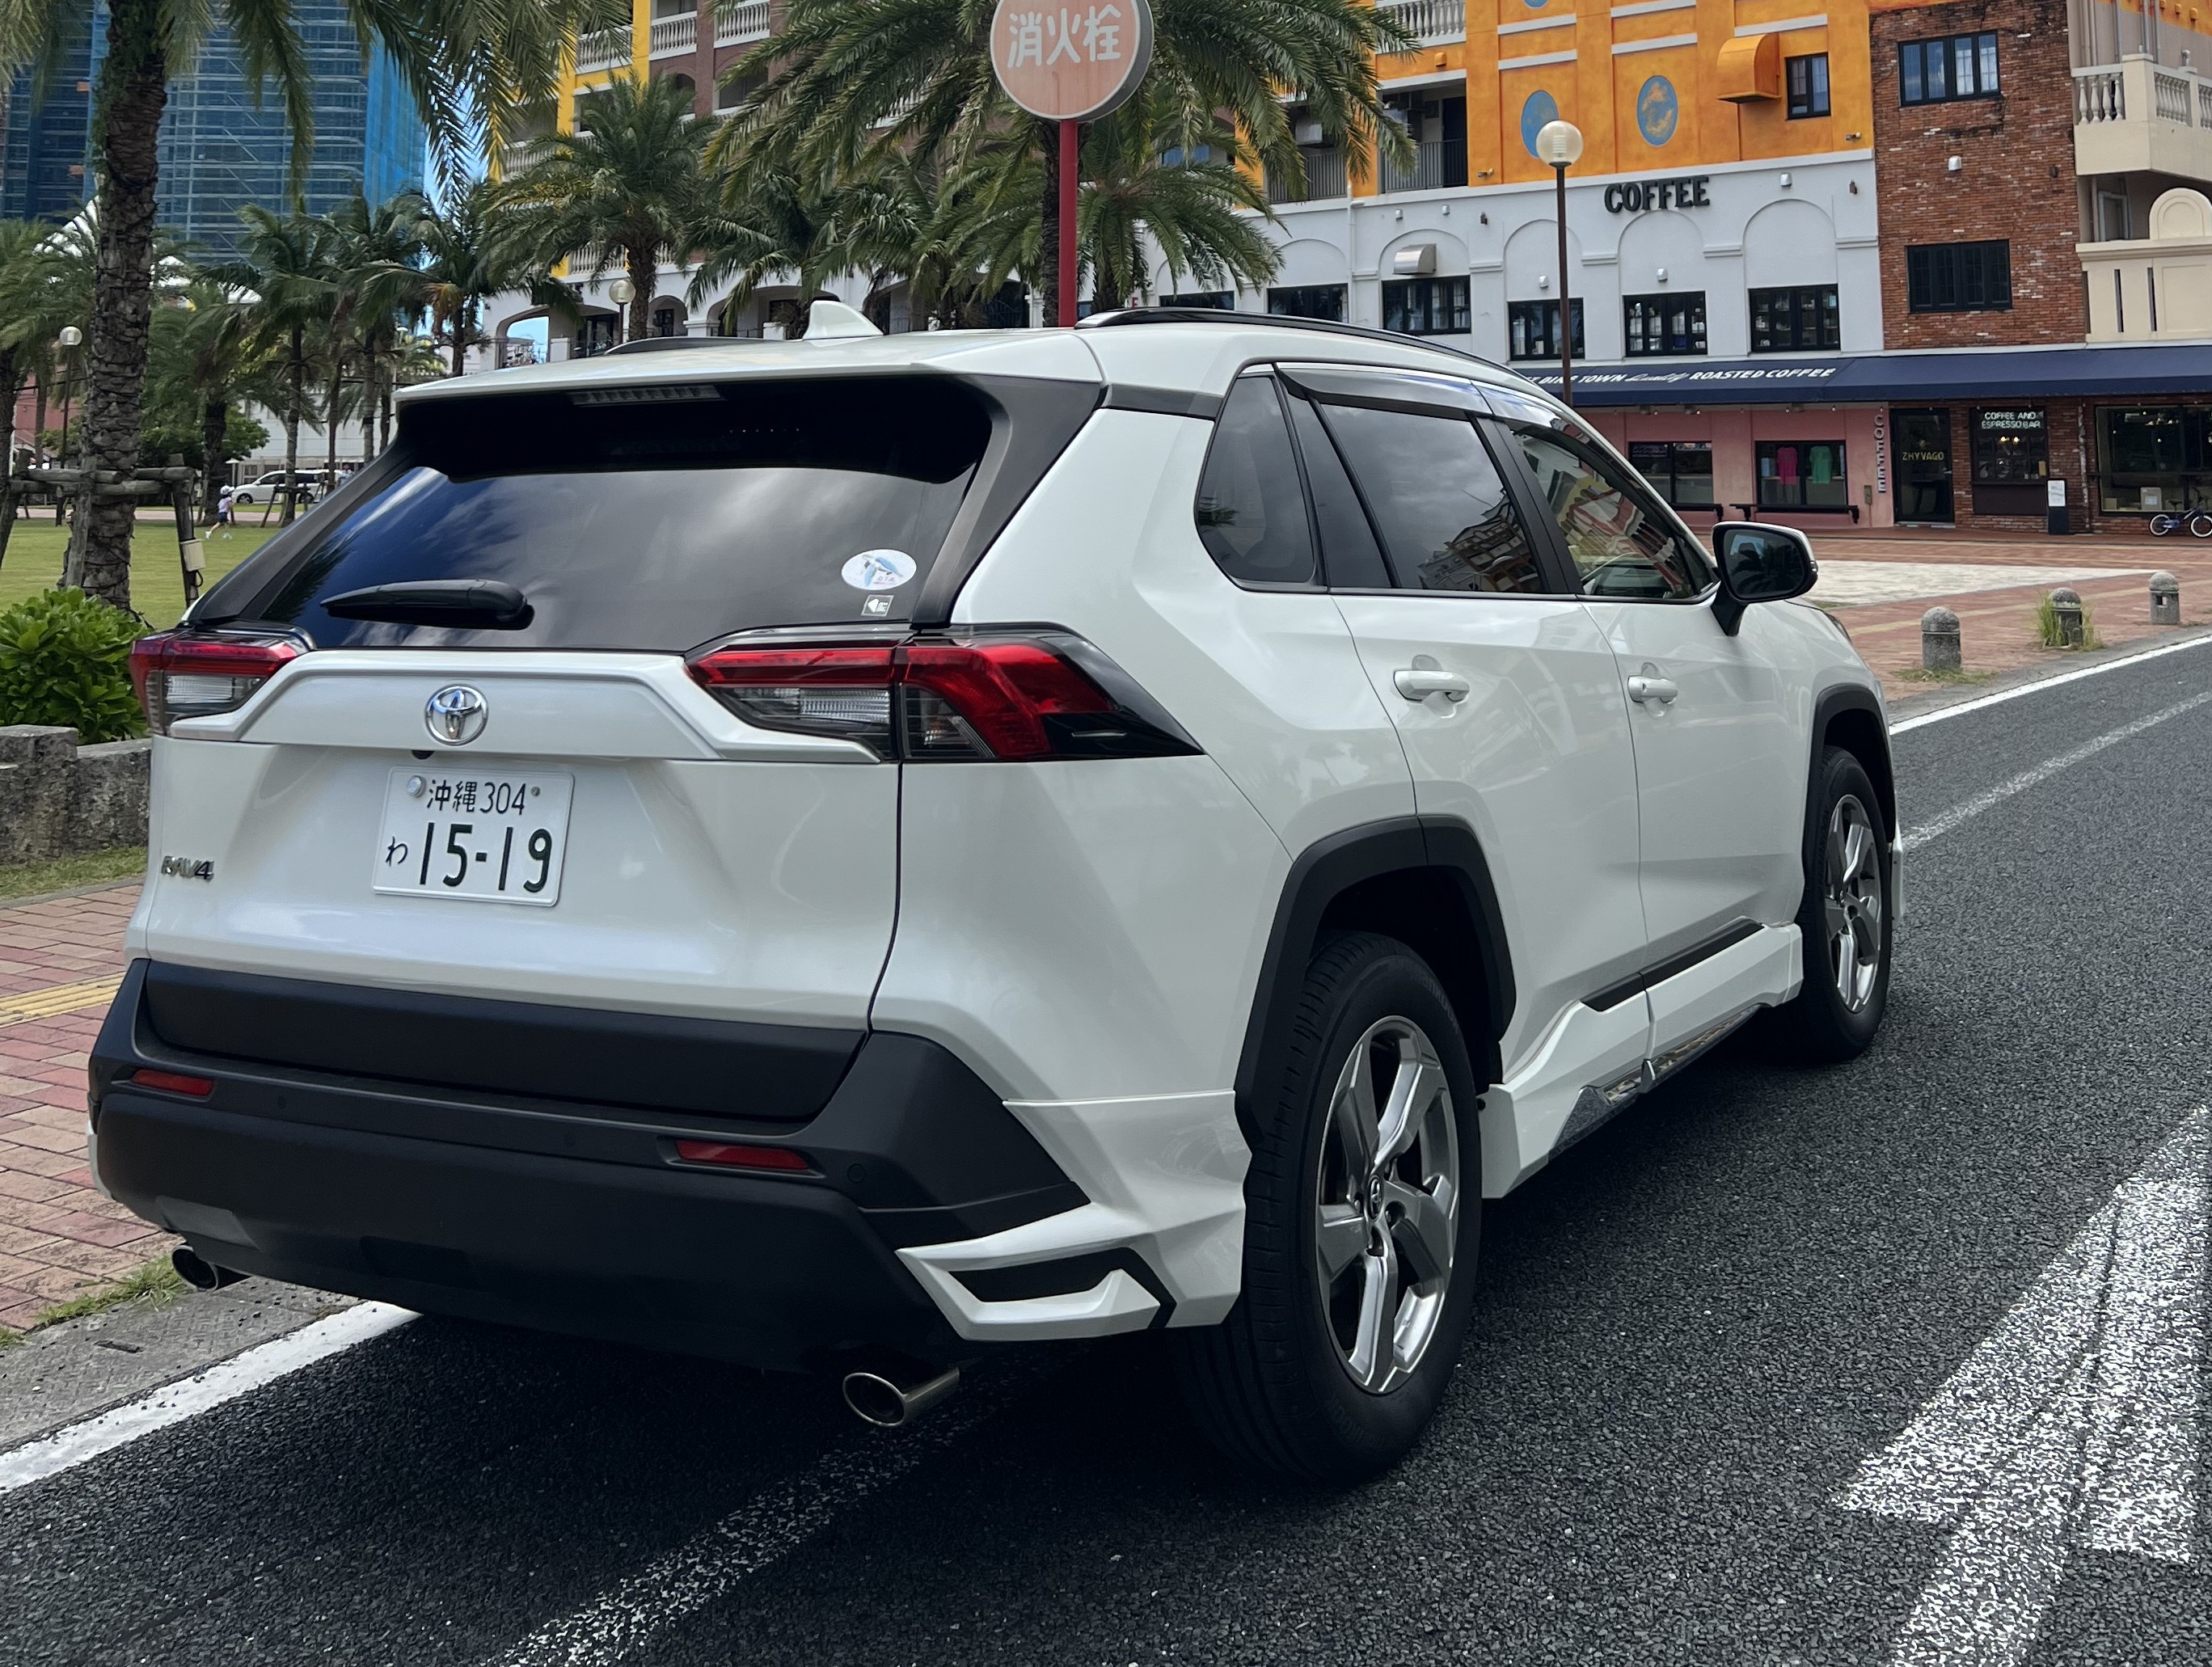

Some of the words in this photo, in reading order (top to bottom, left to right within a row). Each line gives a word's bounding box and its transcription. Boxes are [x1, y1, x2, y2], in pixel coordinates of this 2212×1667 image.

[1007, 4, 1121, 68] 消火栓
[1604, 175, 1710, 213] COFFEE
[1578, 373, 1627, 383] TOWN
[1689, 369, 1766, 380] ROASTED
[1765, 368, 1837, 378] COFFEE
[1981, 420, 2022, 429] ESPRESSO
[2022, 420, 2041, 428] BAR
[1984, 411, 2015, 420] COFFEE
[2017, 411, 2037, 420] AND
[1873, 413, 1887, 493] COFFEE
[1902, 450, 1945, 462] ZHYVAGO
[161, 855, 215, 883] RAV4
[385, 836, 408, 867] わ
[419, 821, 553, 893] 15-19
